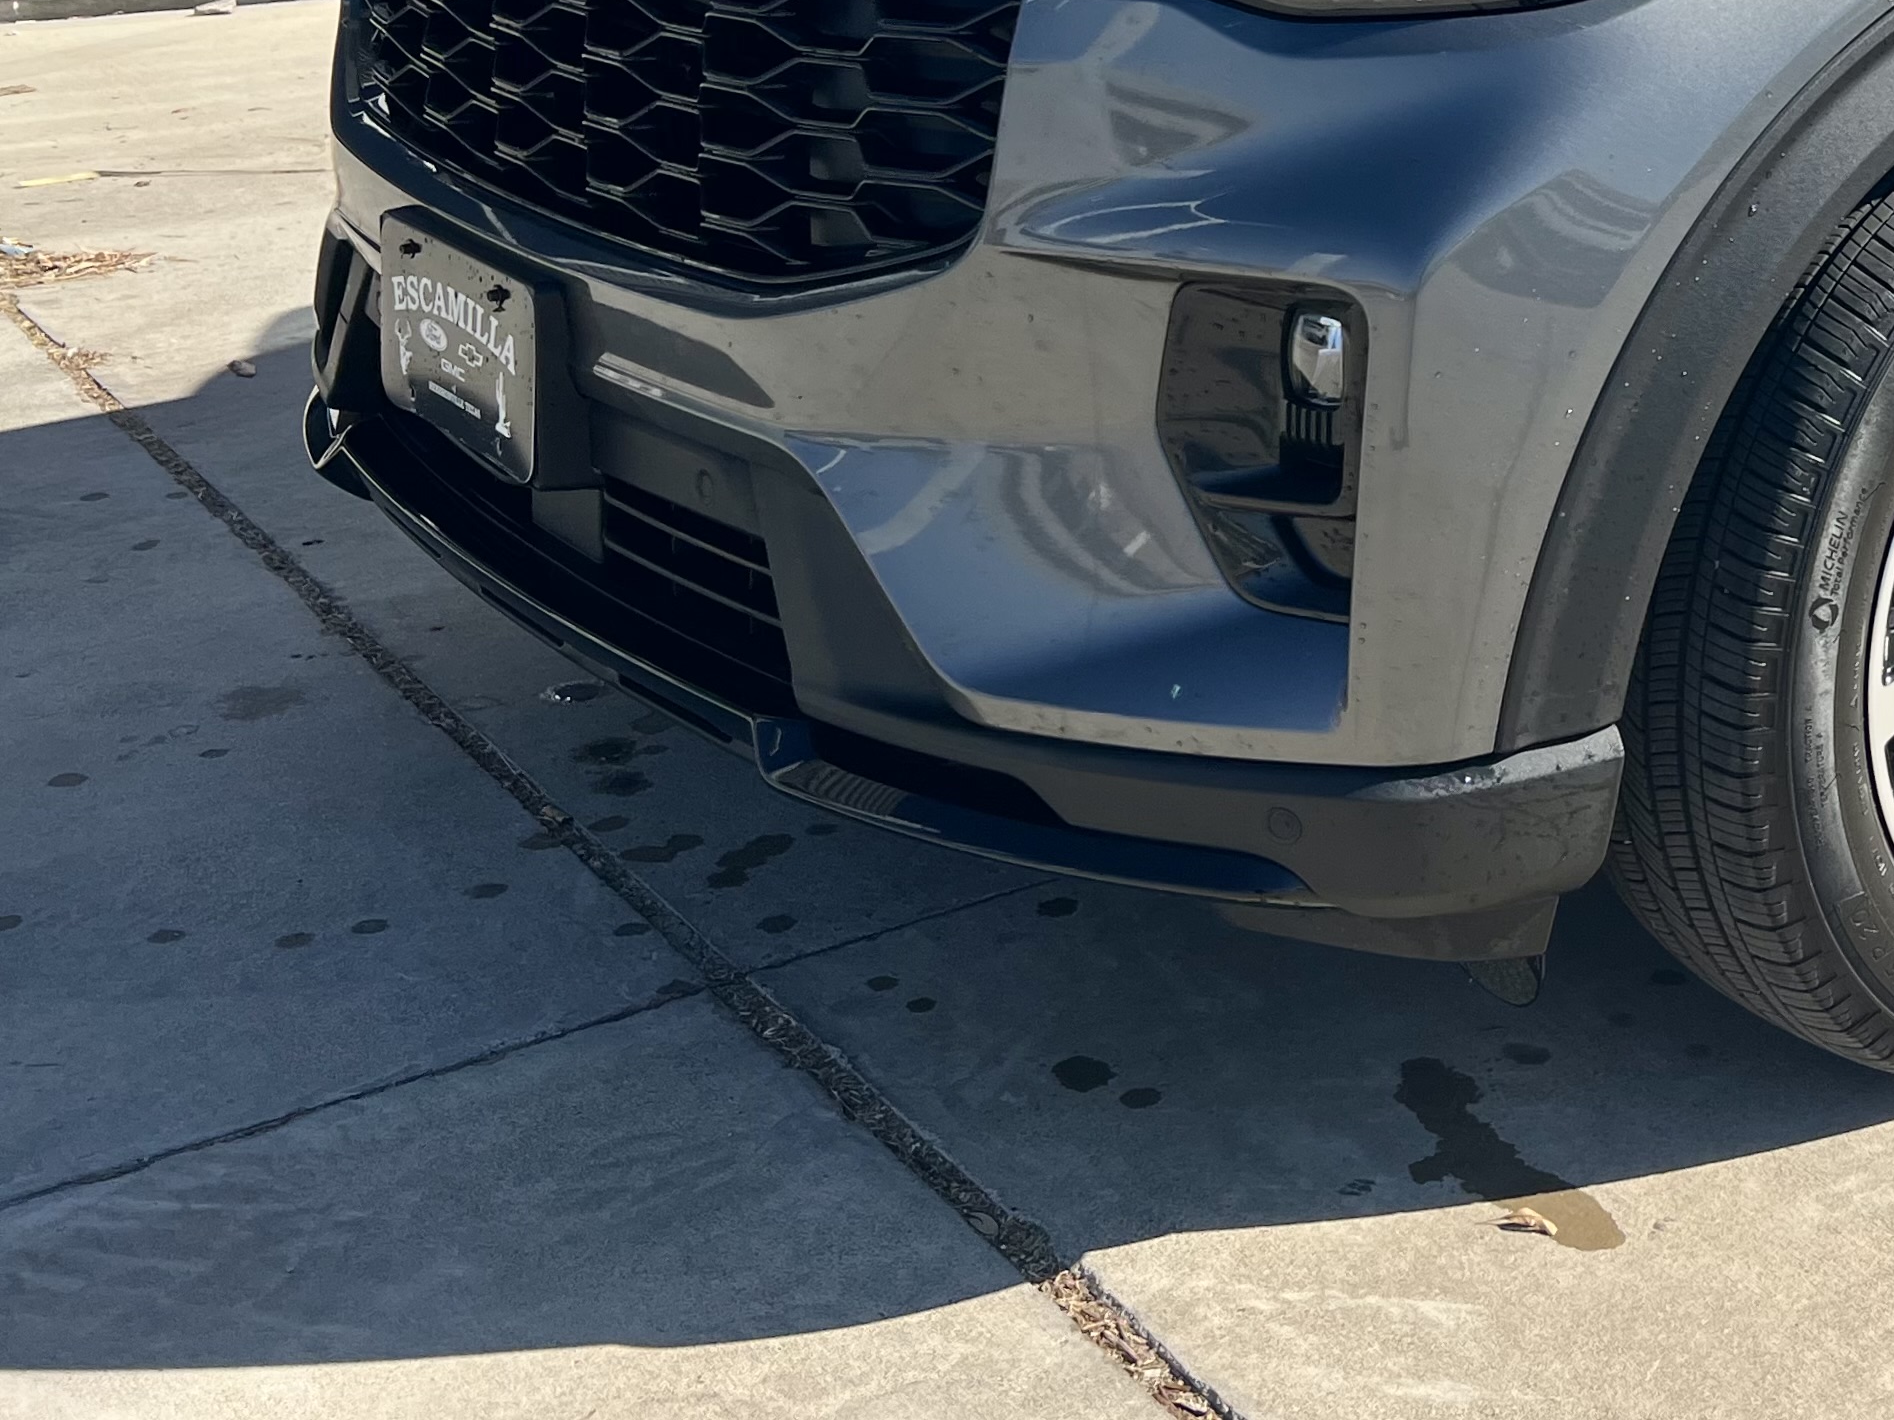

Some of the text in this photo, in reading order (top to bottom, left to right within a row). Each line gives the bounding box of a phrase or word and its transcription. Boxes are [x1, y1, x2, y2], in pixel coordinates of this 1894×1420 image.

[391, 275, 517, 376] ESCAMILLA
[441, 357, 466, 383] GMC
[1819, 510, 1848, 591] MICHELIN
[1830, 566, 1844, 596] Total
